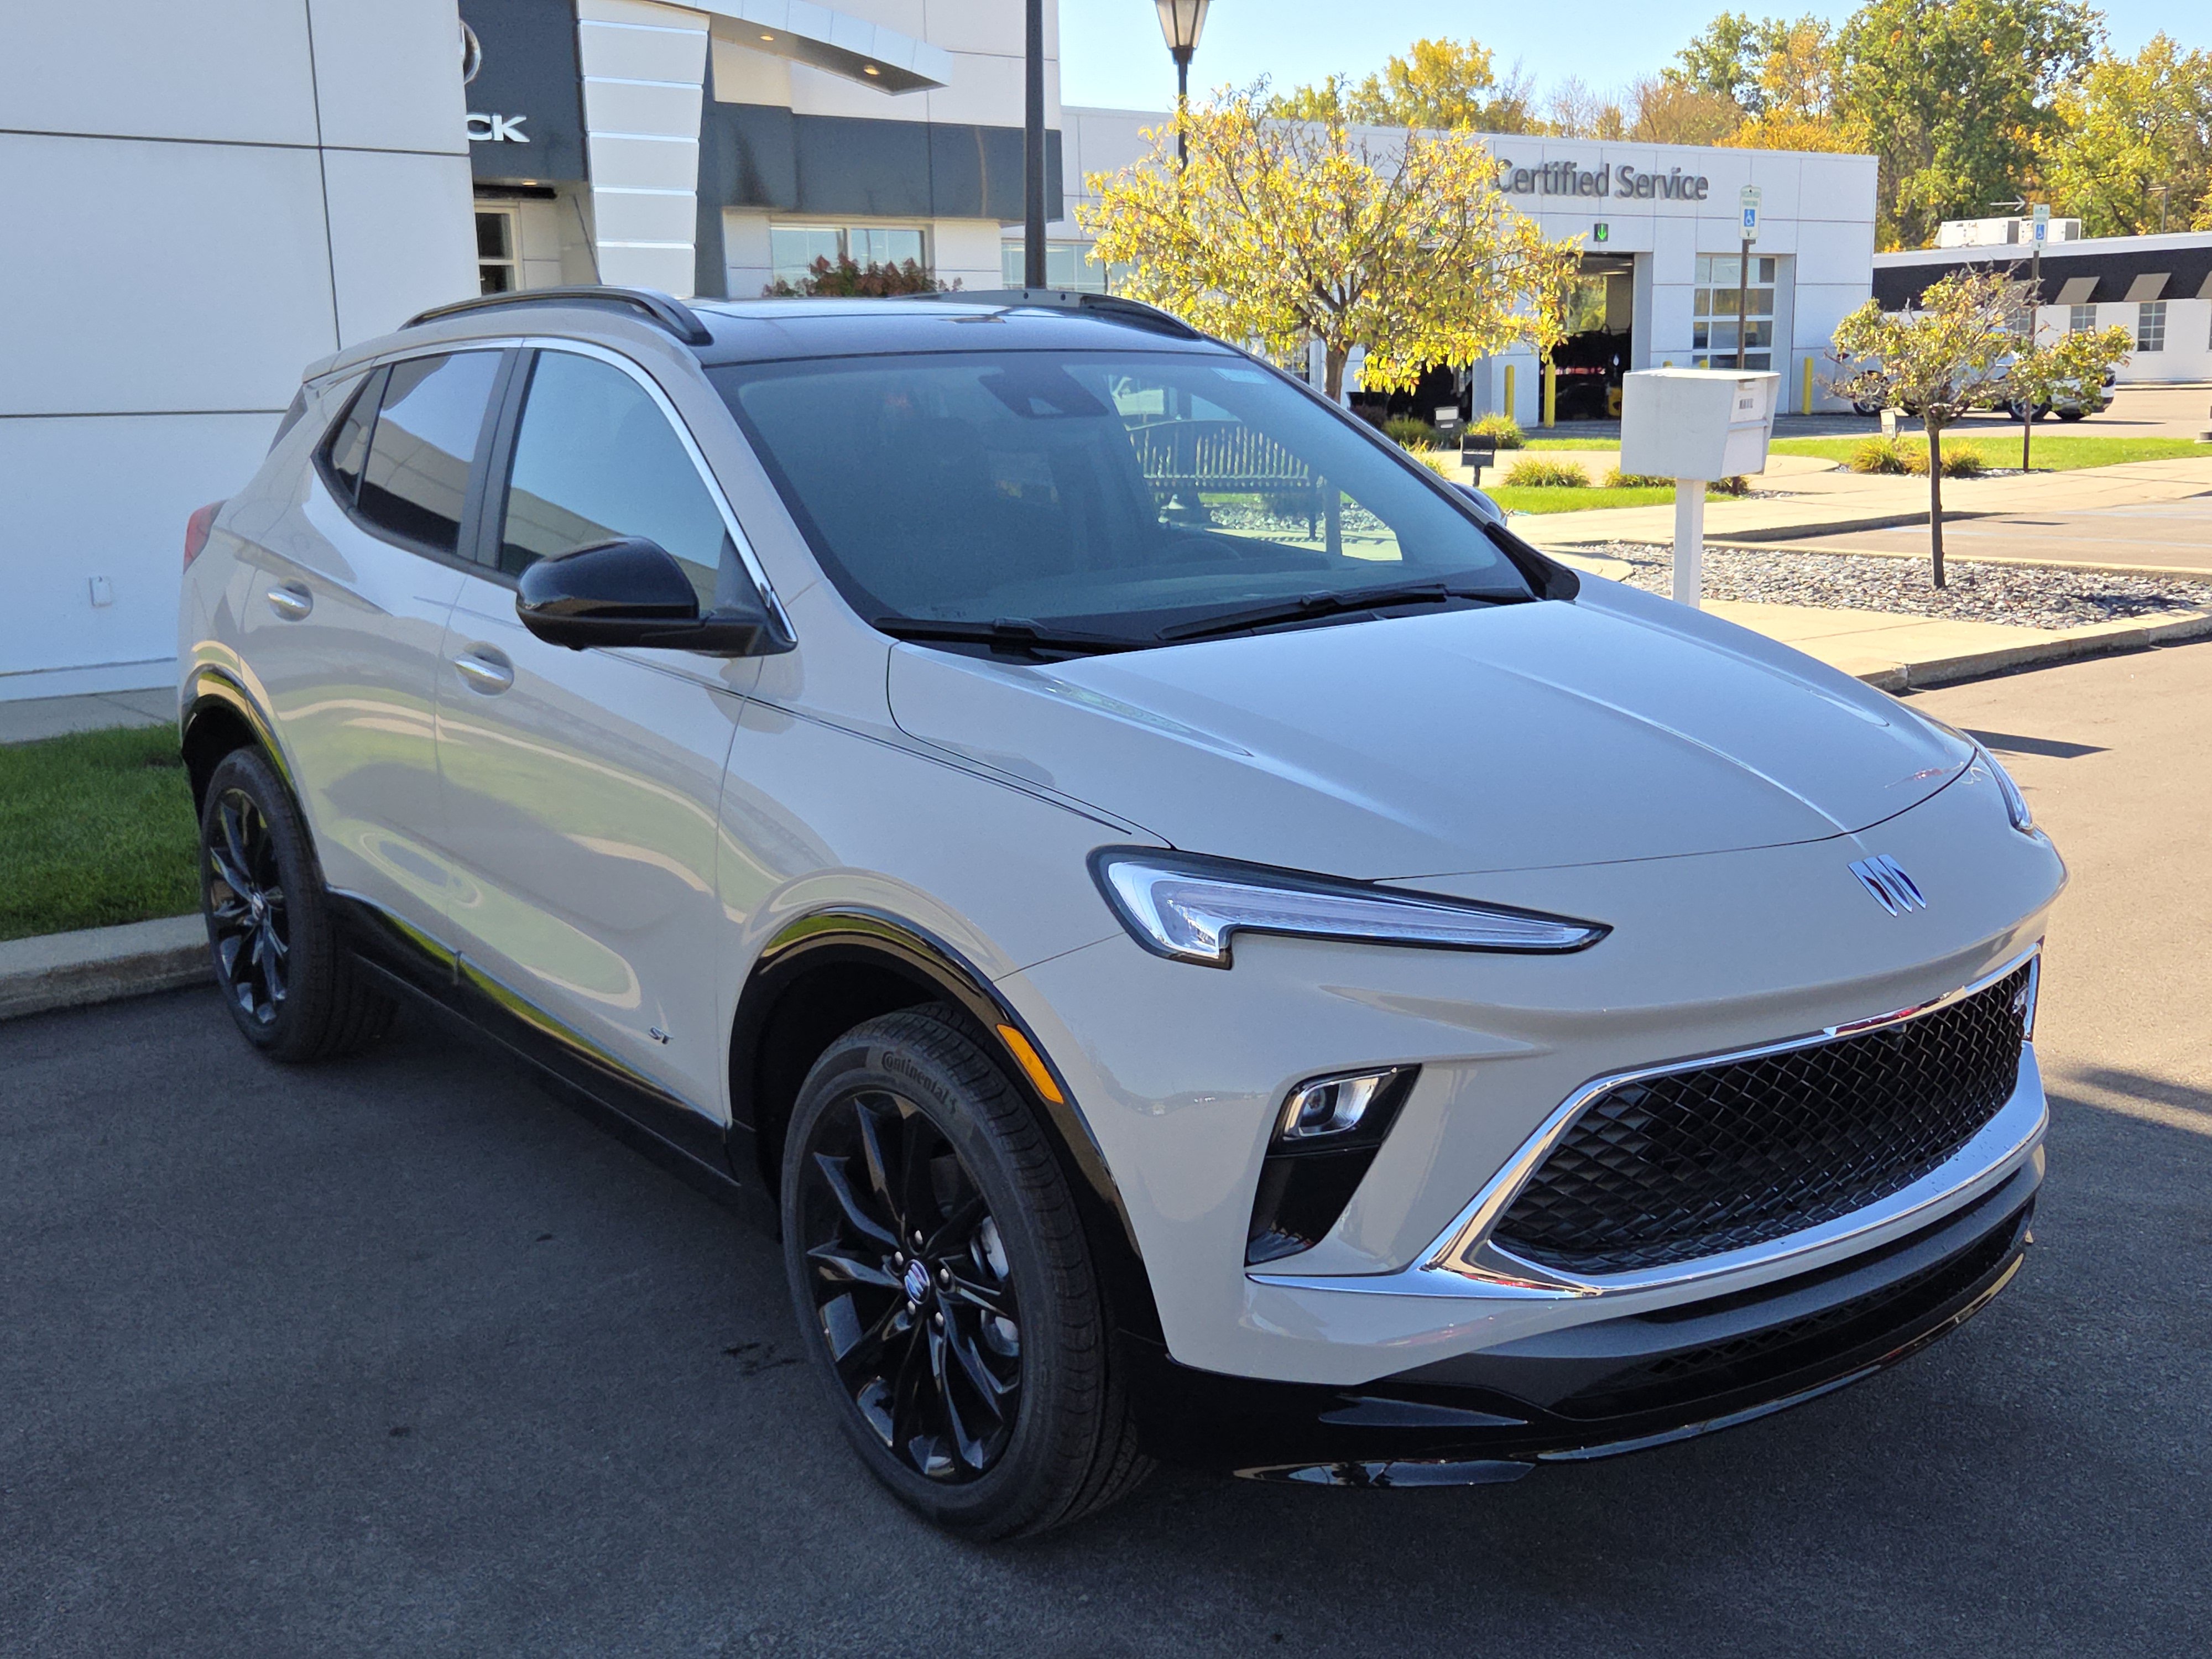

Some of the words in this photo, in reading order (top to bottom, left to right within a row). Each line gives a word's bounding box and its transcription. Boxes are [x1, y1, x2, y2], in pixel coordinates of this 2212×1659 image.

[1495, 159, 1610, 197] Certified
[1616, 165, 1709, 200] Service
[881, 1051, 950, 1104] Continental
